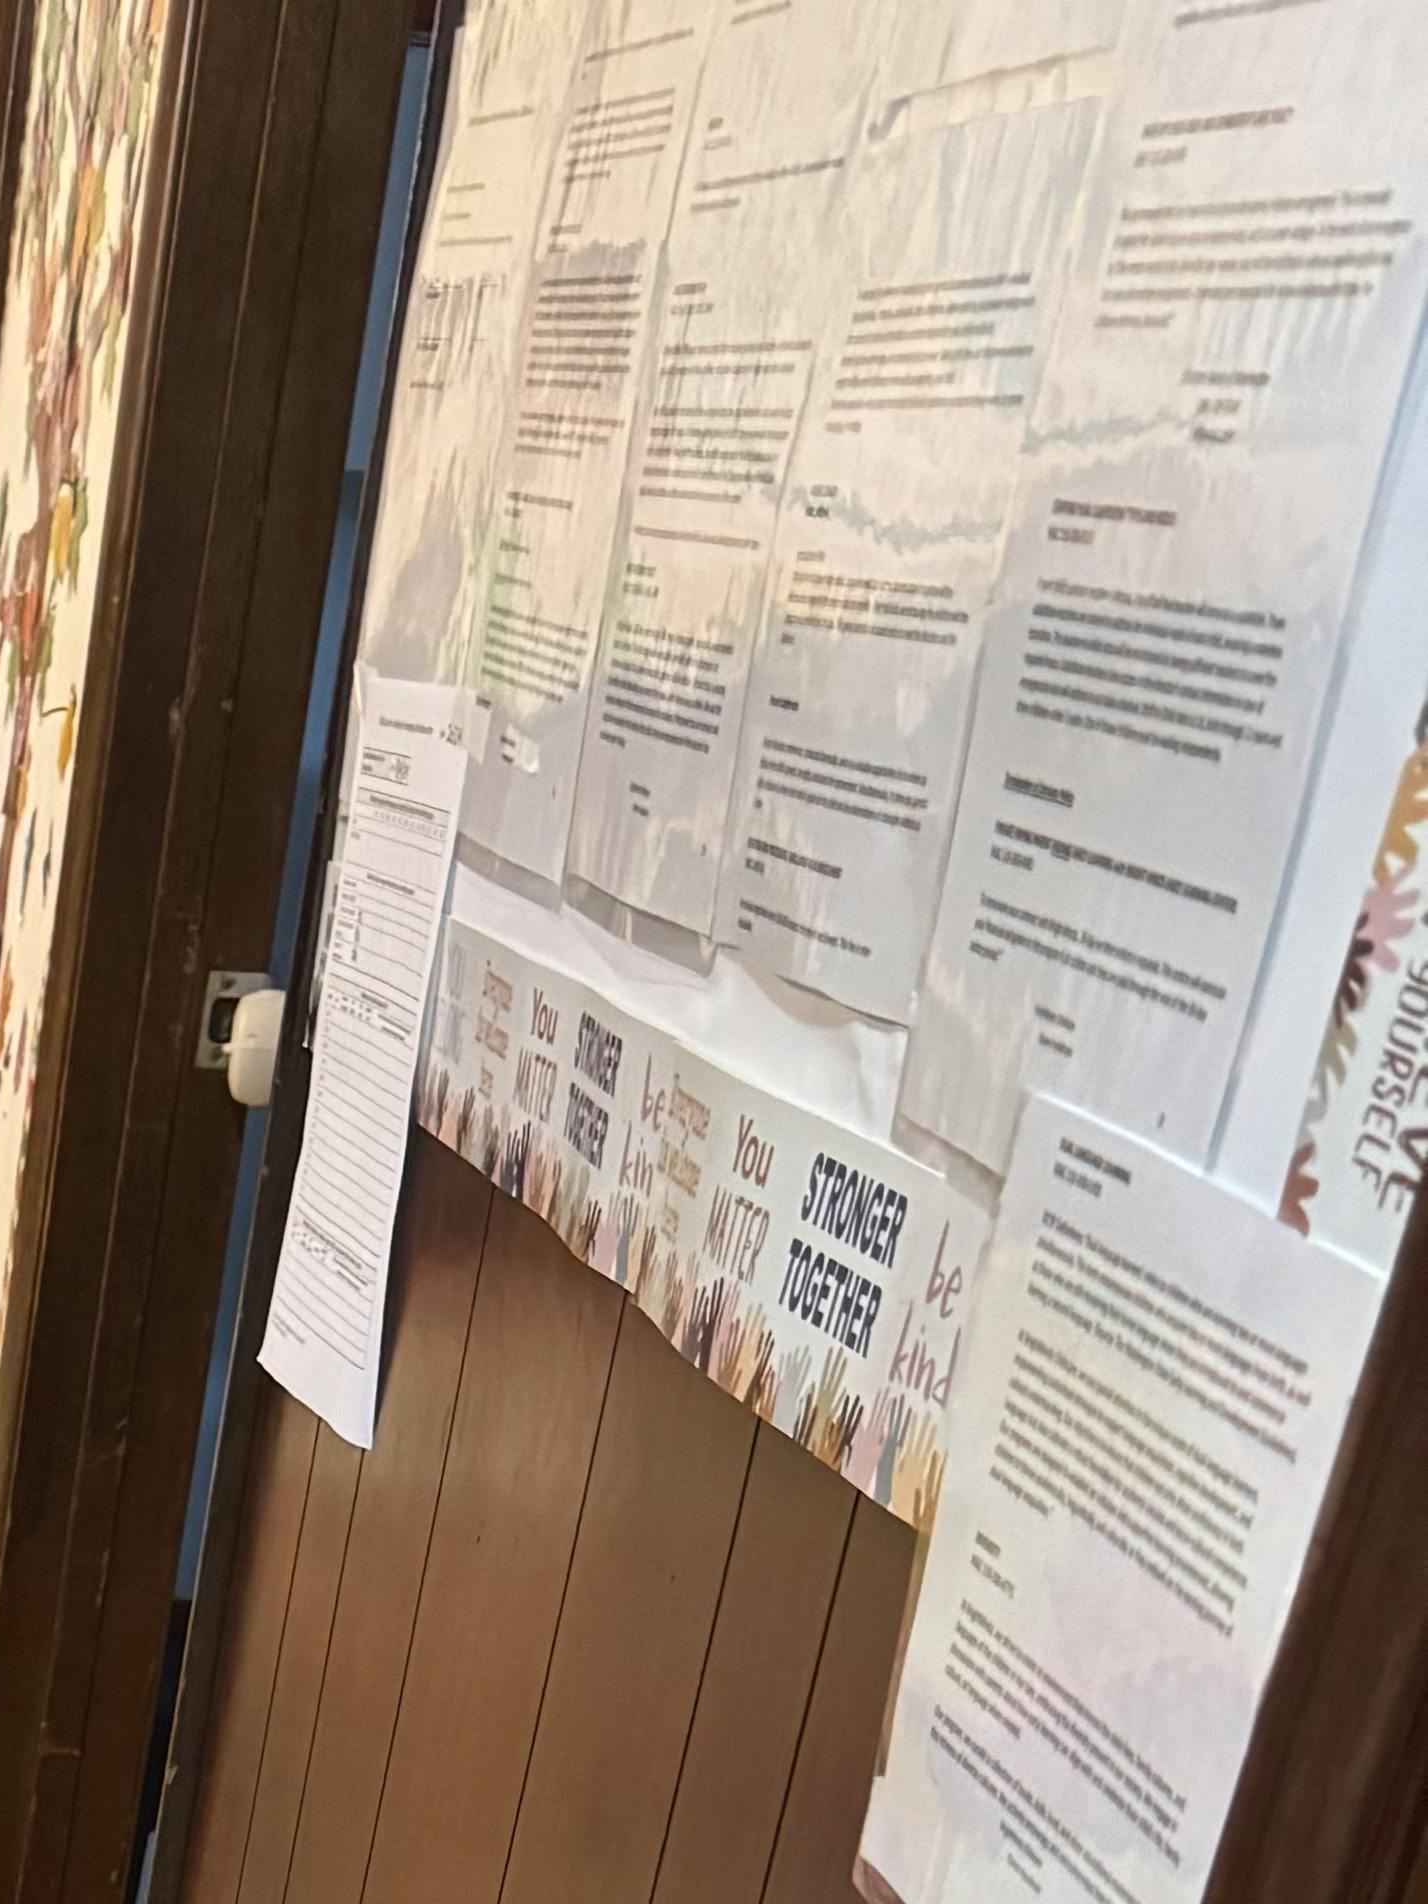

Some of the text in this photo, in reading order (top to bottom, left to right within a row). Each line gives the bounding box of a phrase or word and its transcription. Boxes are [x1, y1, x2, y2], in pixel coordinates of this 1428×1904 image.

[529, 986, 560, 1047] You
[618, 1119, 655, 1199] kin
[731, 1113, 776, 1189] You
[701, 1183, 772, 1287] MATTER
[799, 1151, 909, 1270] STRONGER
[777, 1237, 883, 1360] TOGETHER
[924, 1217, 964, 1320] be
[887, 1299, 963, 1405] kind
